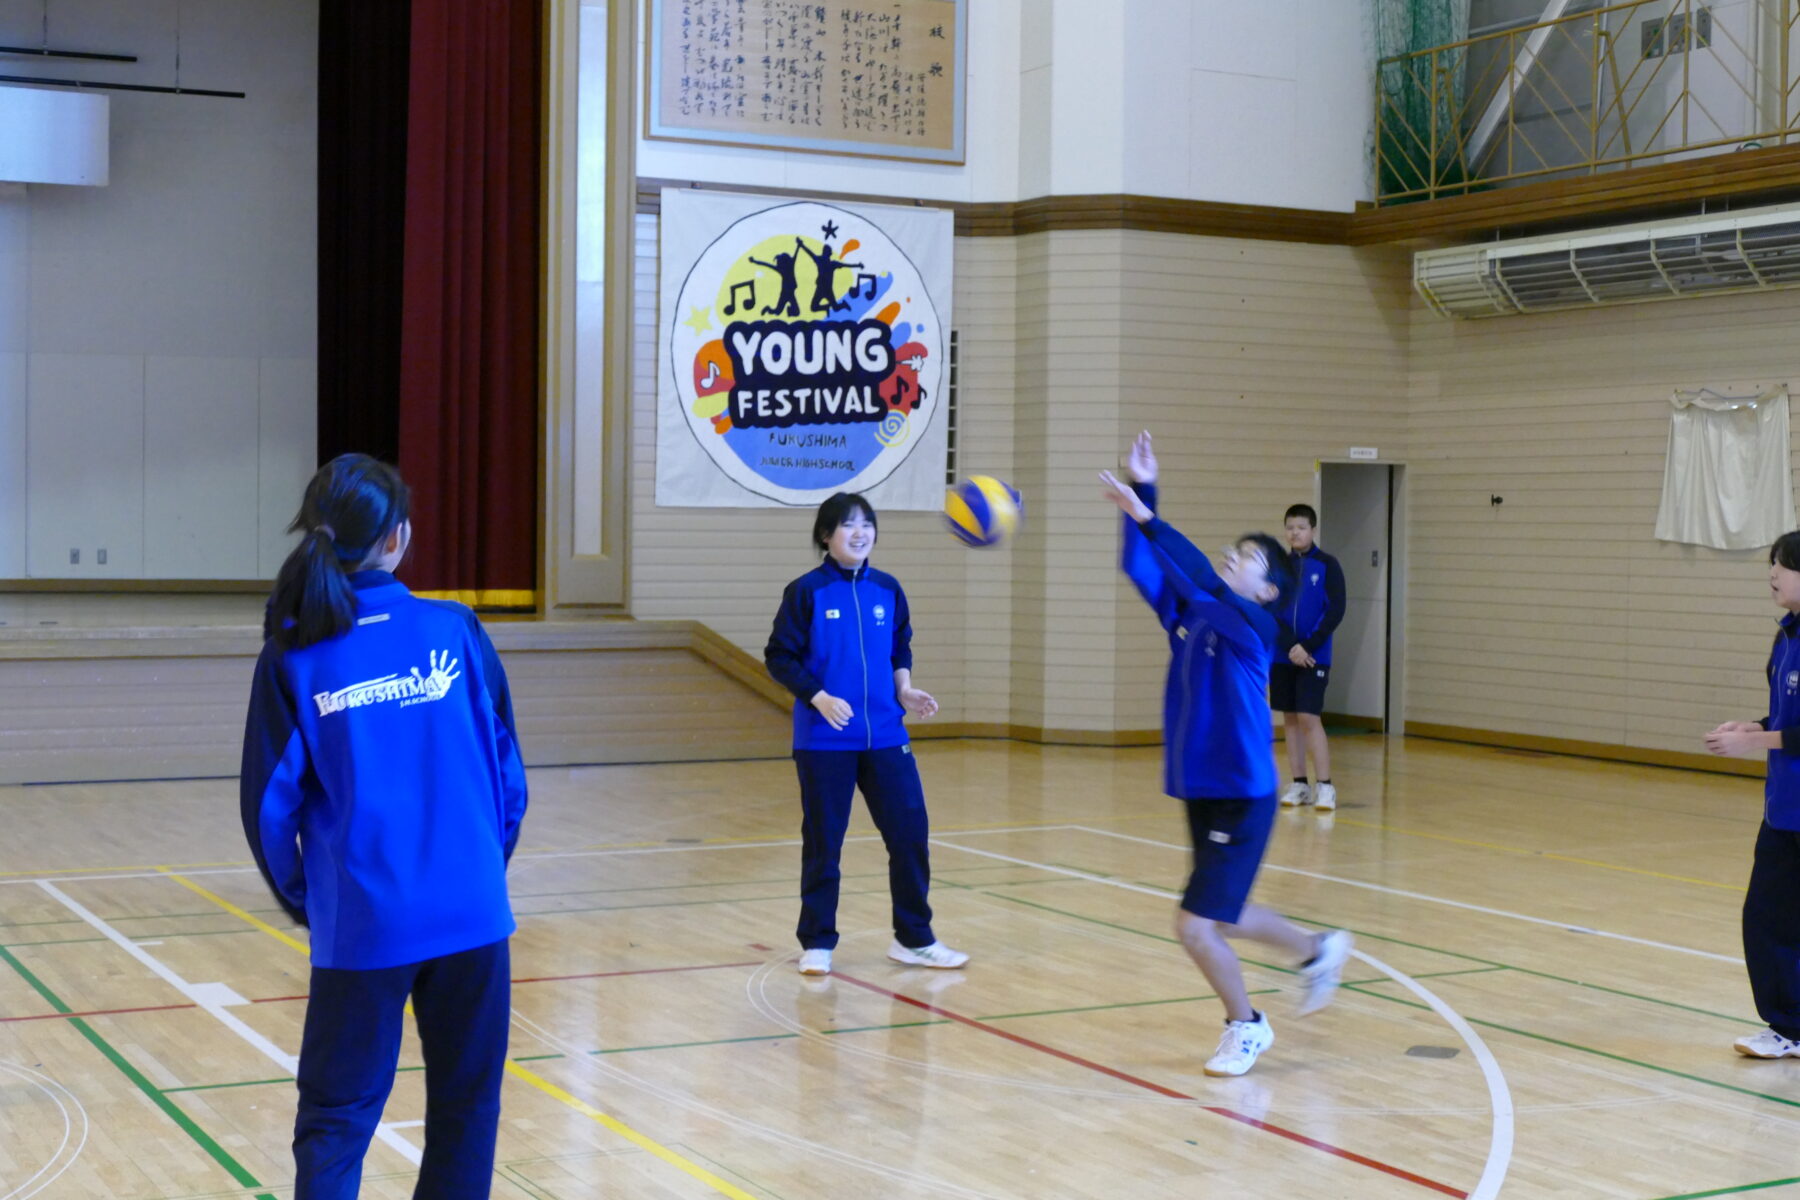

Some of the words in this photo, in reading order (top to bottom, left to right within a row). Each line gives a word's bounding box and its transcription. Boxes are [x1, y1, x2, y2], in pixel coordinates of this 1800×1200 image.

[731, 326, 889, 375] YOUNG
[736, 385, 881, 419] FESTIVAL
[768, 431, 848, 449] FUKUSHIMA
[314, 673, 443, 717] FUKUSHIMA
